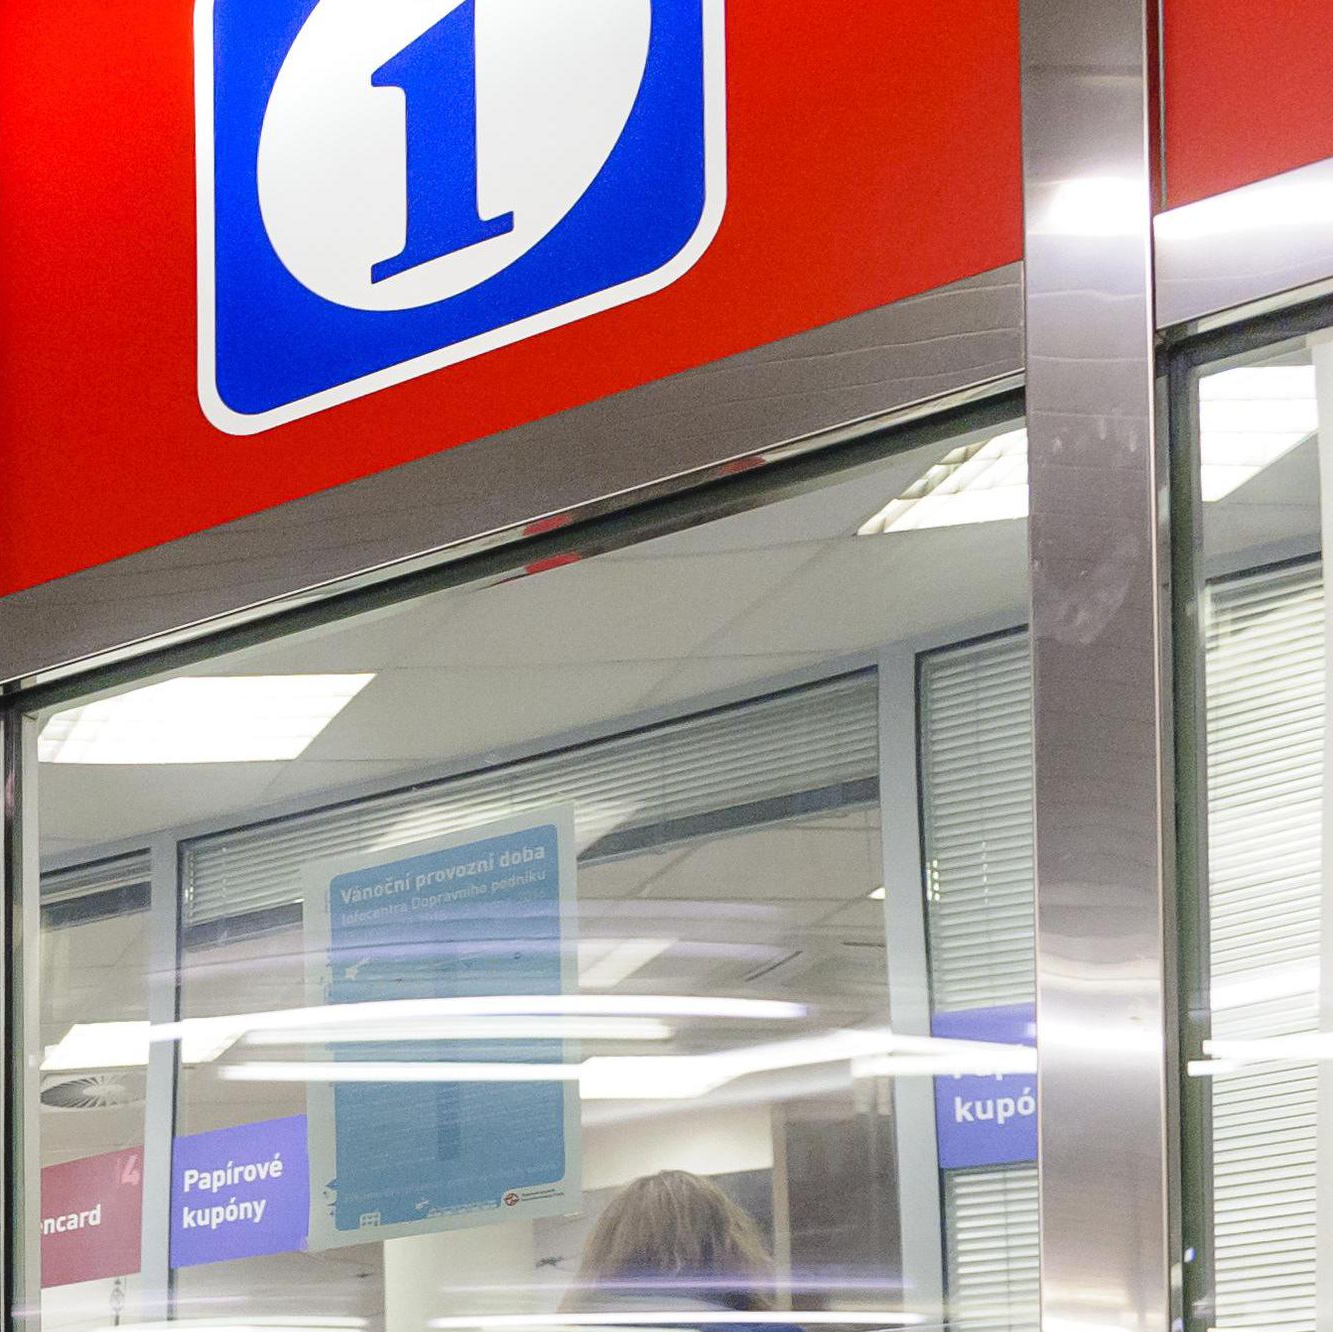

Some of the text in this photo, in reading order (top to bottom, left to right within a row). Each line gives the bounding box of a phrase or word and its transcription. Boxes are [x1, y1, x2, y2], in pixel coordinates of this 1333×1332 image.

[500, 846, 546, 868] doba
[184, 1153, 284, 1192] Papírové
[183, 1197, 267, 1231] kupóny
